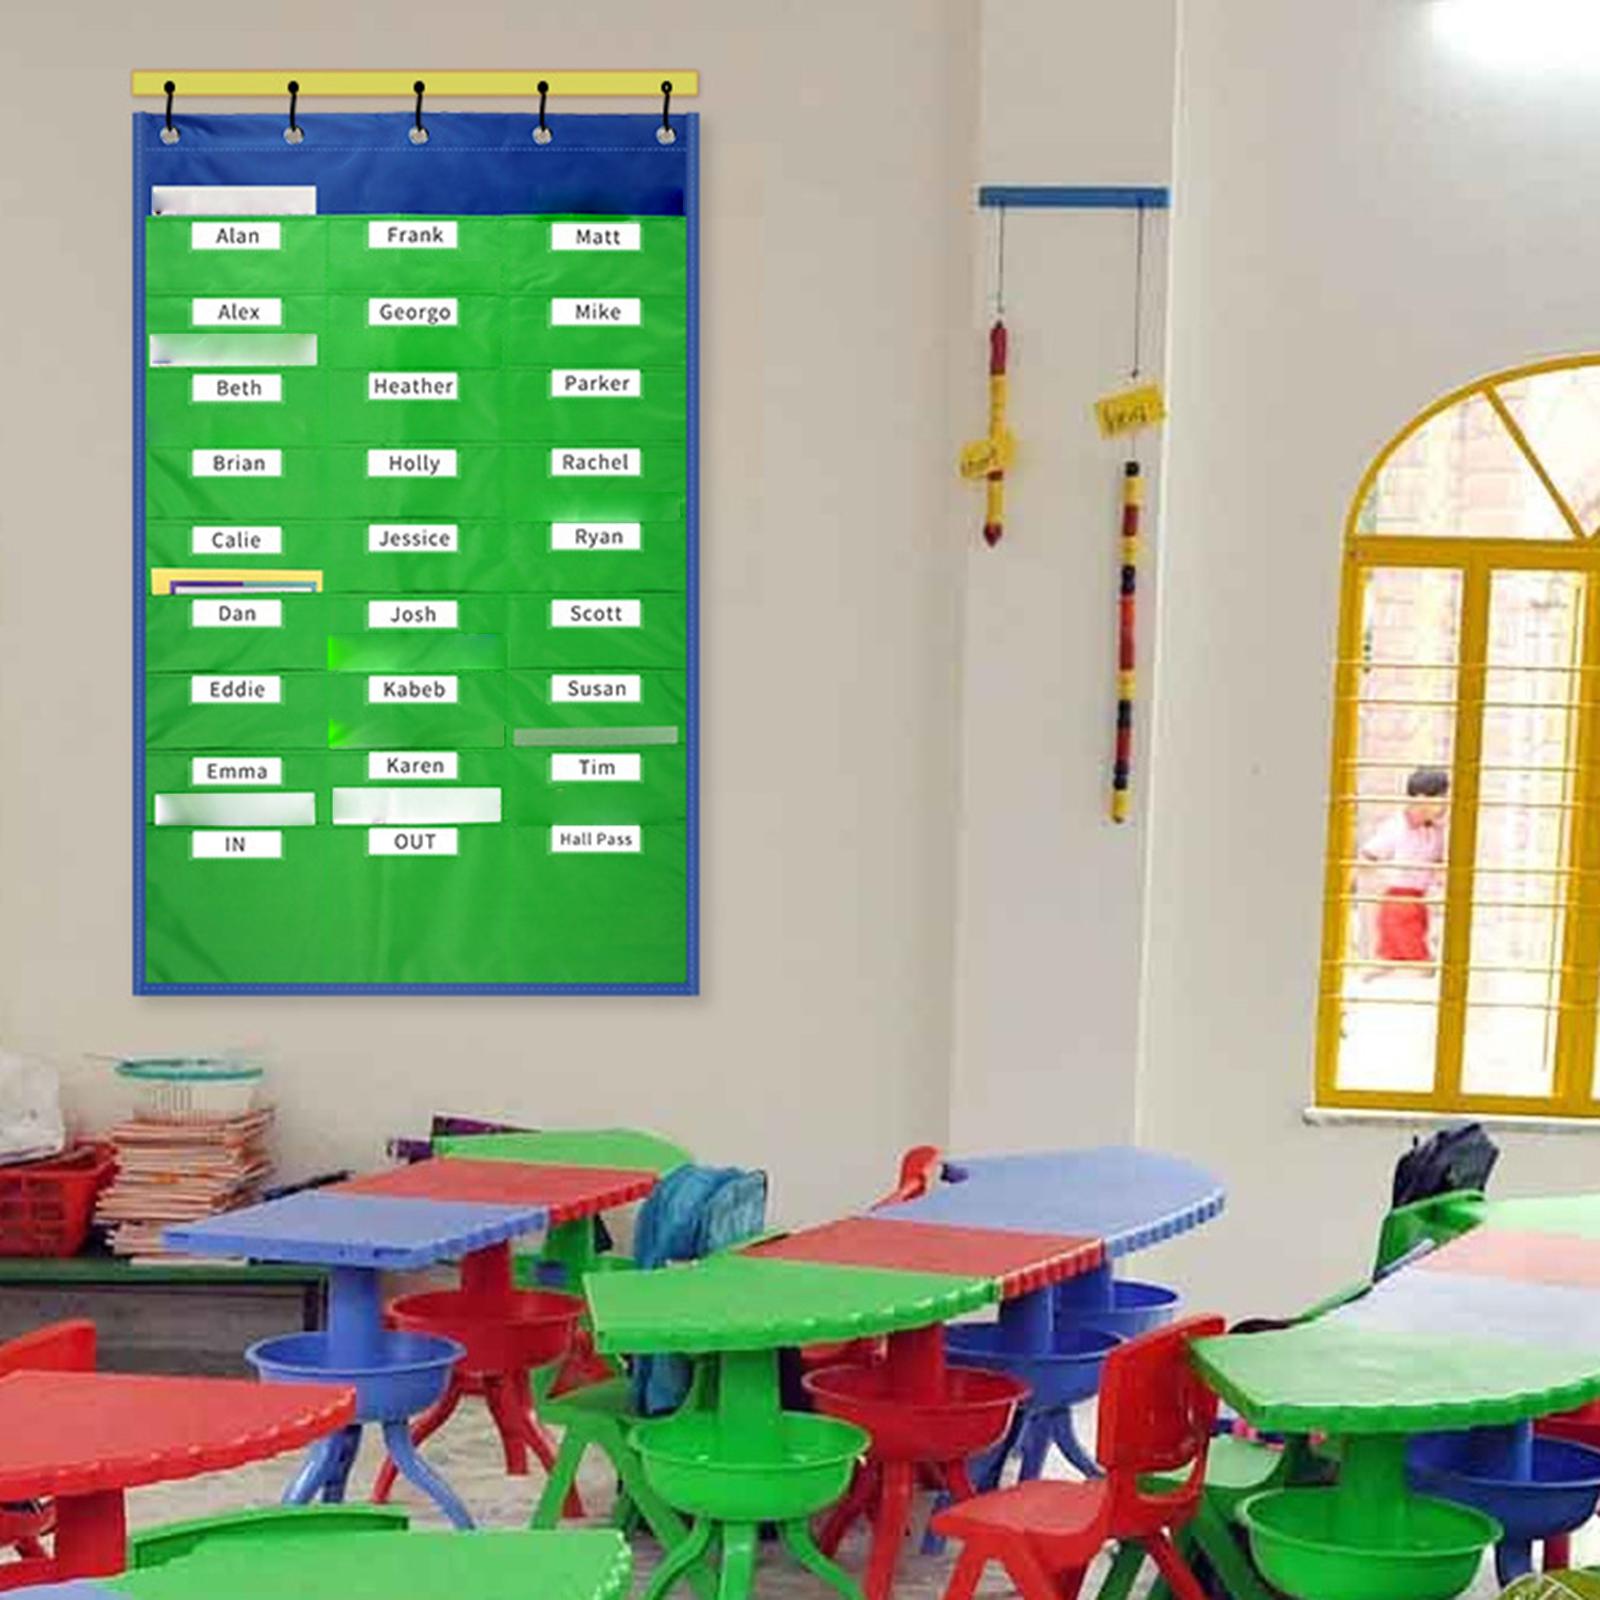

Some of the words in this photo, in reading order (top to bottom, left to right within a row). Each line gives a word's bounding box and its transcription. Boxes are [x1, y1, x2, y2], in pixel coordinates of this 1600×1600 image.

[216, 227, 259, 244] Alan
[387, 226, 443, 243] Frank
[576, 229, 620, 245] Matt
[218, 303, 260, 321] Alex
[379, 303, 451, 325] Georgo
[575, 303, 621, 321] Mike
[216, 379, 262, 397] Beth
[374, 377, 453, 395] Heather
[565, 375, 630, 392] Parker
[213, 455, 265, 472] Brian
[389, 454, 441, 476] Holly
[562, 453, 628, 471] Rachel
[212, 531, 261, 549] Calie
[379, 531, 450, 547] Jessice
[575, 528, 623, 549] Ryan
[219, 605, 256, 622] Dan
[390, 605, 436, 623] Josh
[570, 605, 622, 622] Scott
[210, 680, 265, 698] Eddie
[383, 681, 446, 698] Kabeb
[568, 680, 626, 697] Susan
[207, 763, 268, 780] Emma
[387, 757, 444, 774] Karen
[579, 759, 616, 775] Tim
[225, 837, 245, 852] IN
[394, 833, 436, 850] OUT
[560, 832, 592, 846] Hall
[596, 832, 633, 846] Pass
